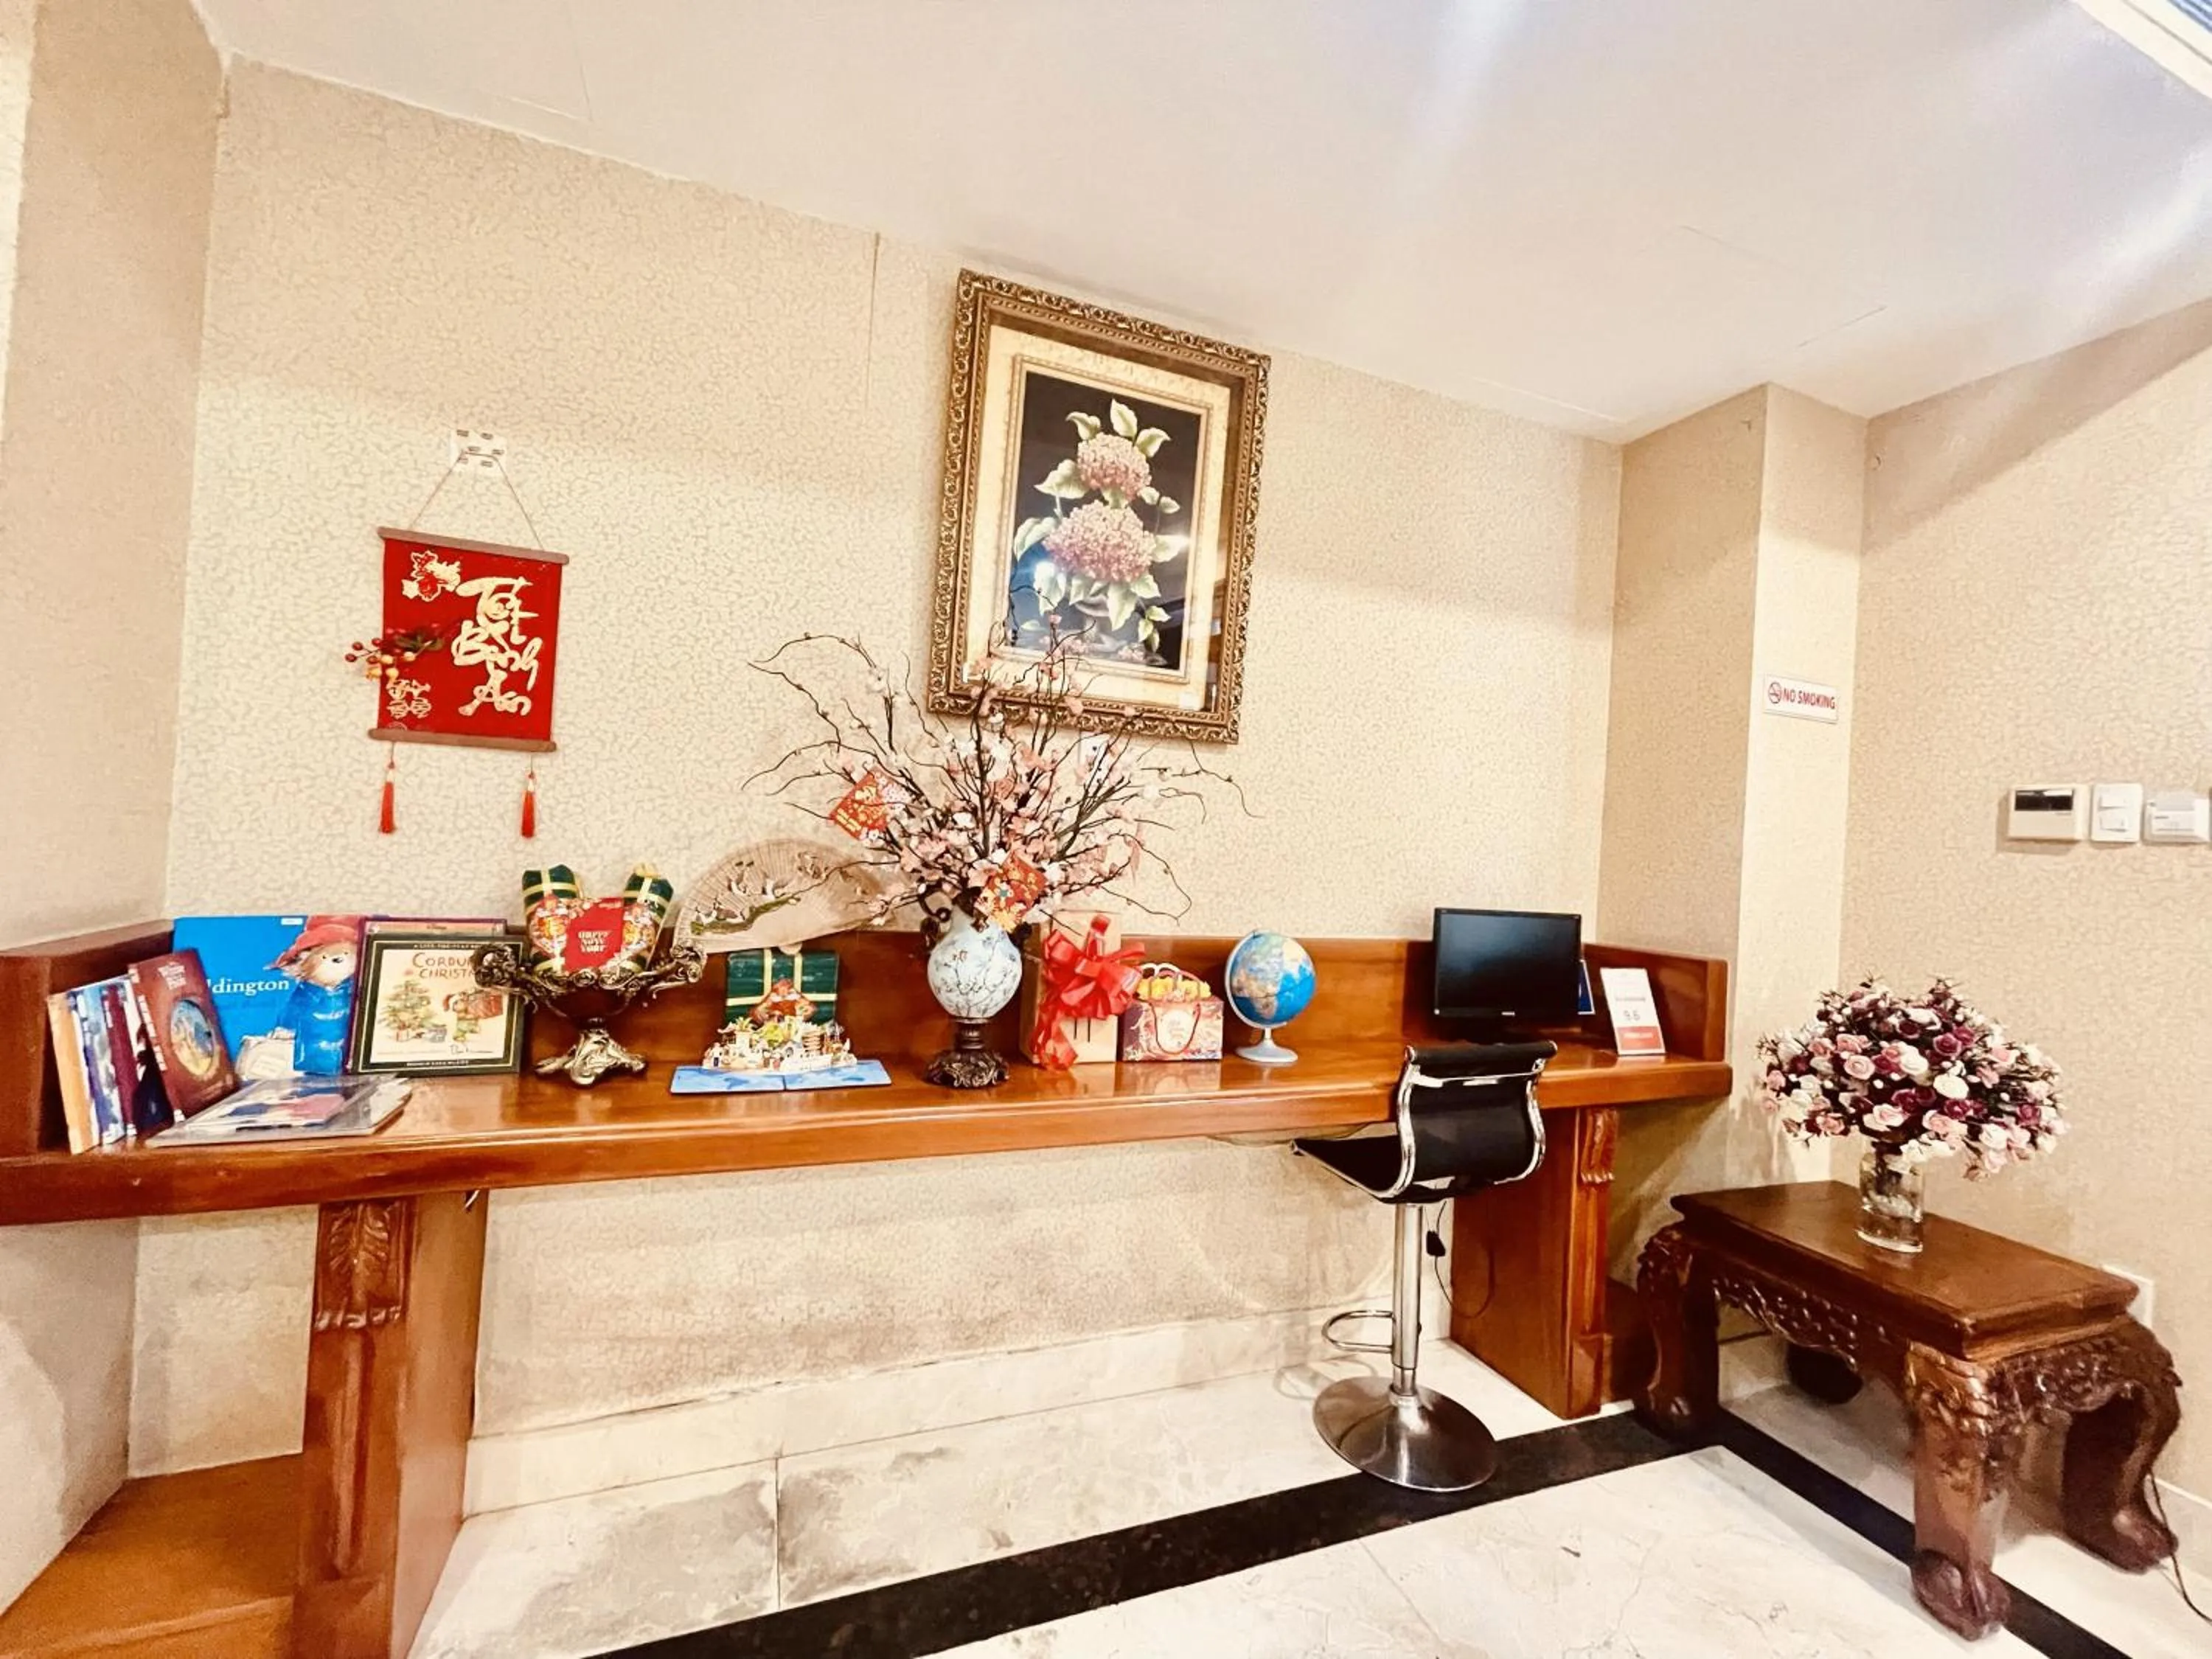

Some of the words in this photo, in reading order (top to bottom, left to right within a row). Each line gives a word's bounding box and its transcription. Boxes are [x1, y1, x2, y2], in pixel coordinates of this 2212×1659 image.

[1783, 687, 1796, 703] NO
[1798, 690, 1835, 709] SMOKING
[412, 952, 472, 968] CORDU
[419, 967, 476, 980] CHRIST
[206, 978, 290, 995] dington
